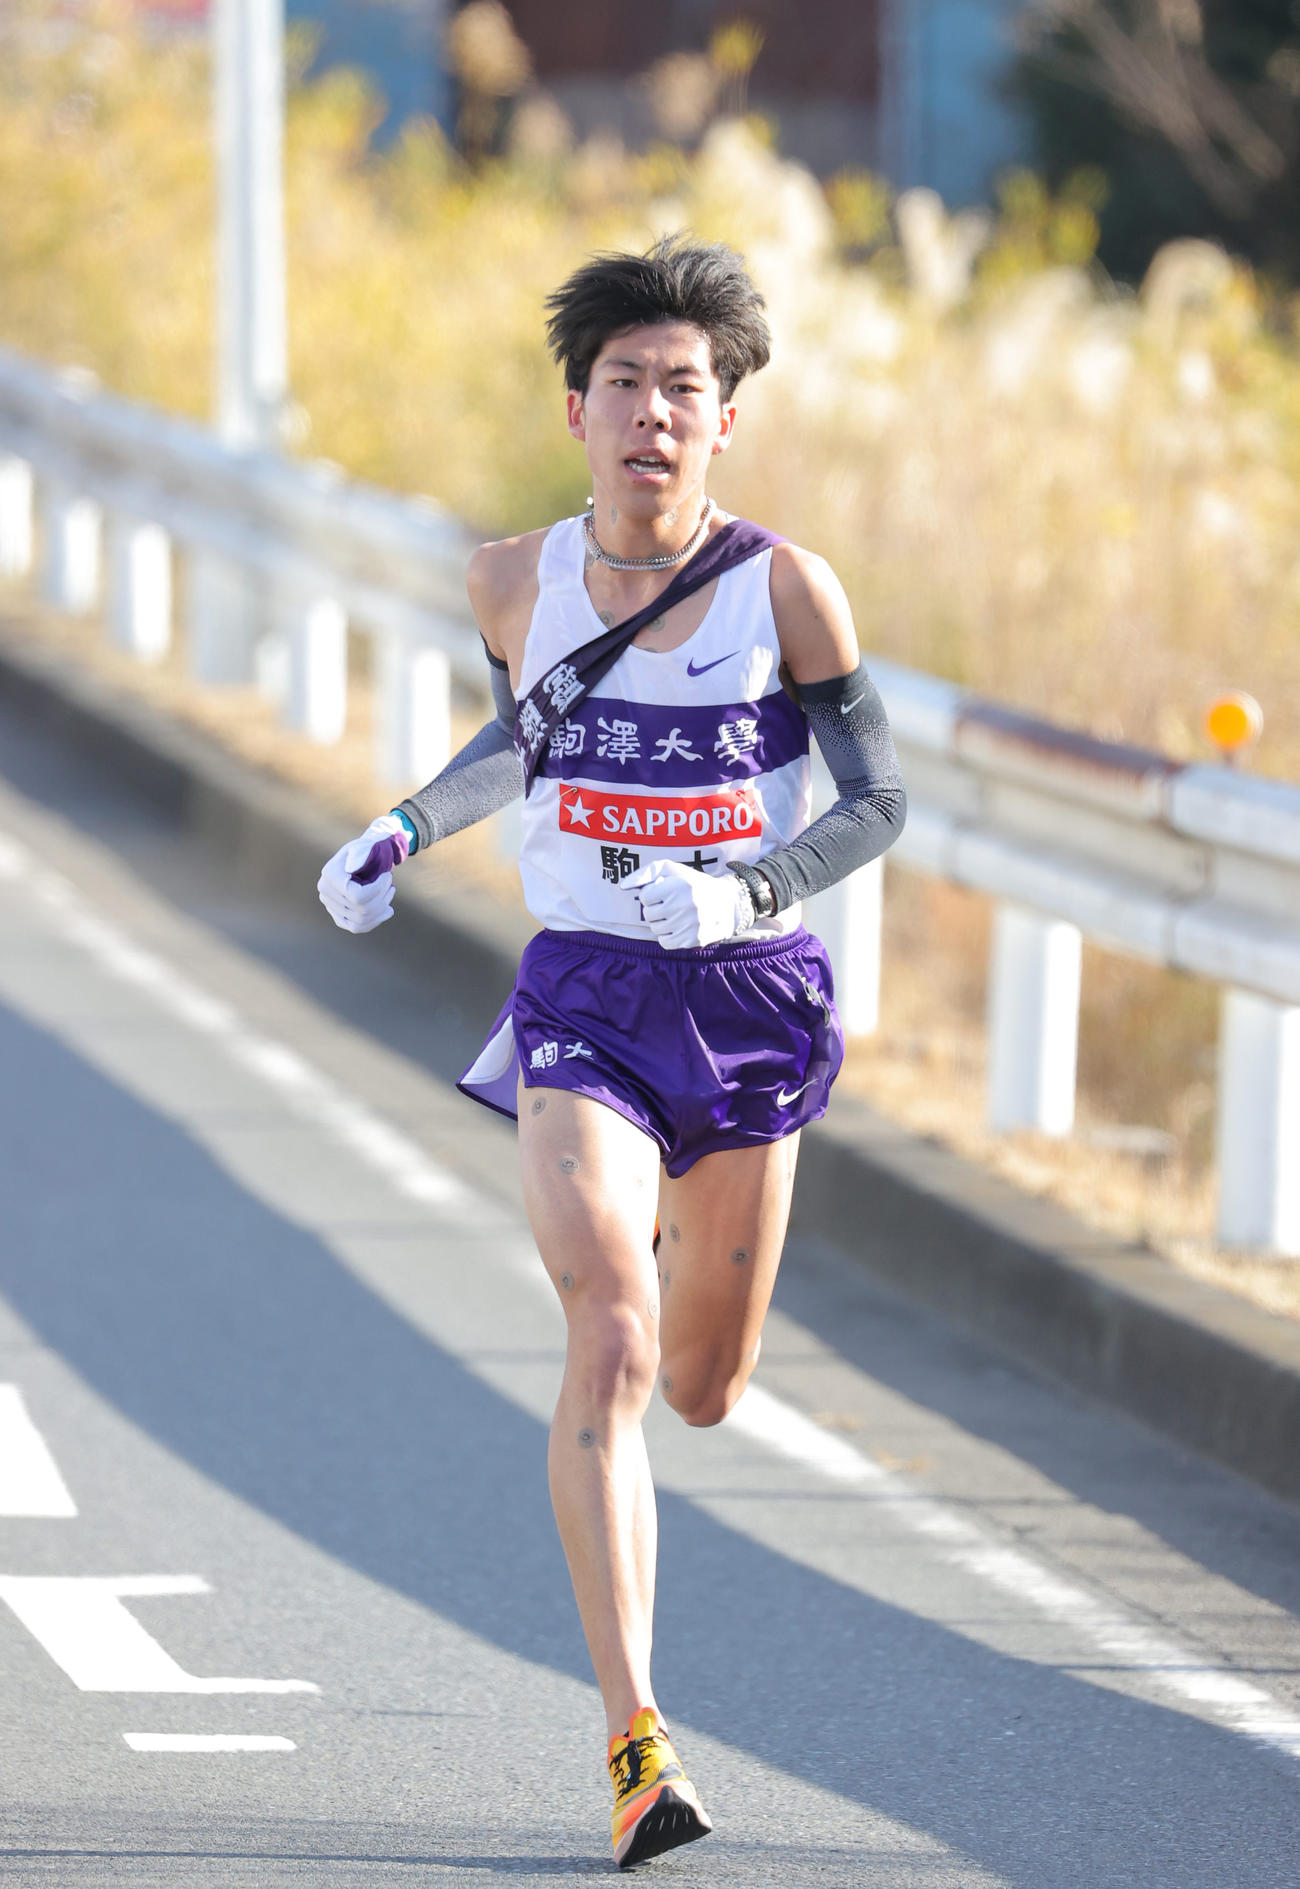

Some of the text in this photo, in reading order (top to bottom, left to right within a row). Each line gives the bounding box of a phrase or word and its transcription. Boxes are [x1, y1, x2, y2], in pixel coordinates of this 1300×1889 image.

[549, 716, 758, 767] 駒澤大學
[602, 802, 754, 838] SAPPORO
[529, 1041, 594, 1070] 駒大
